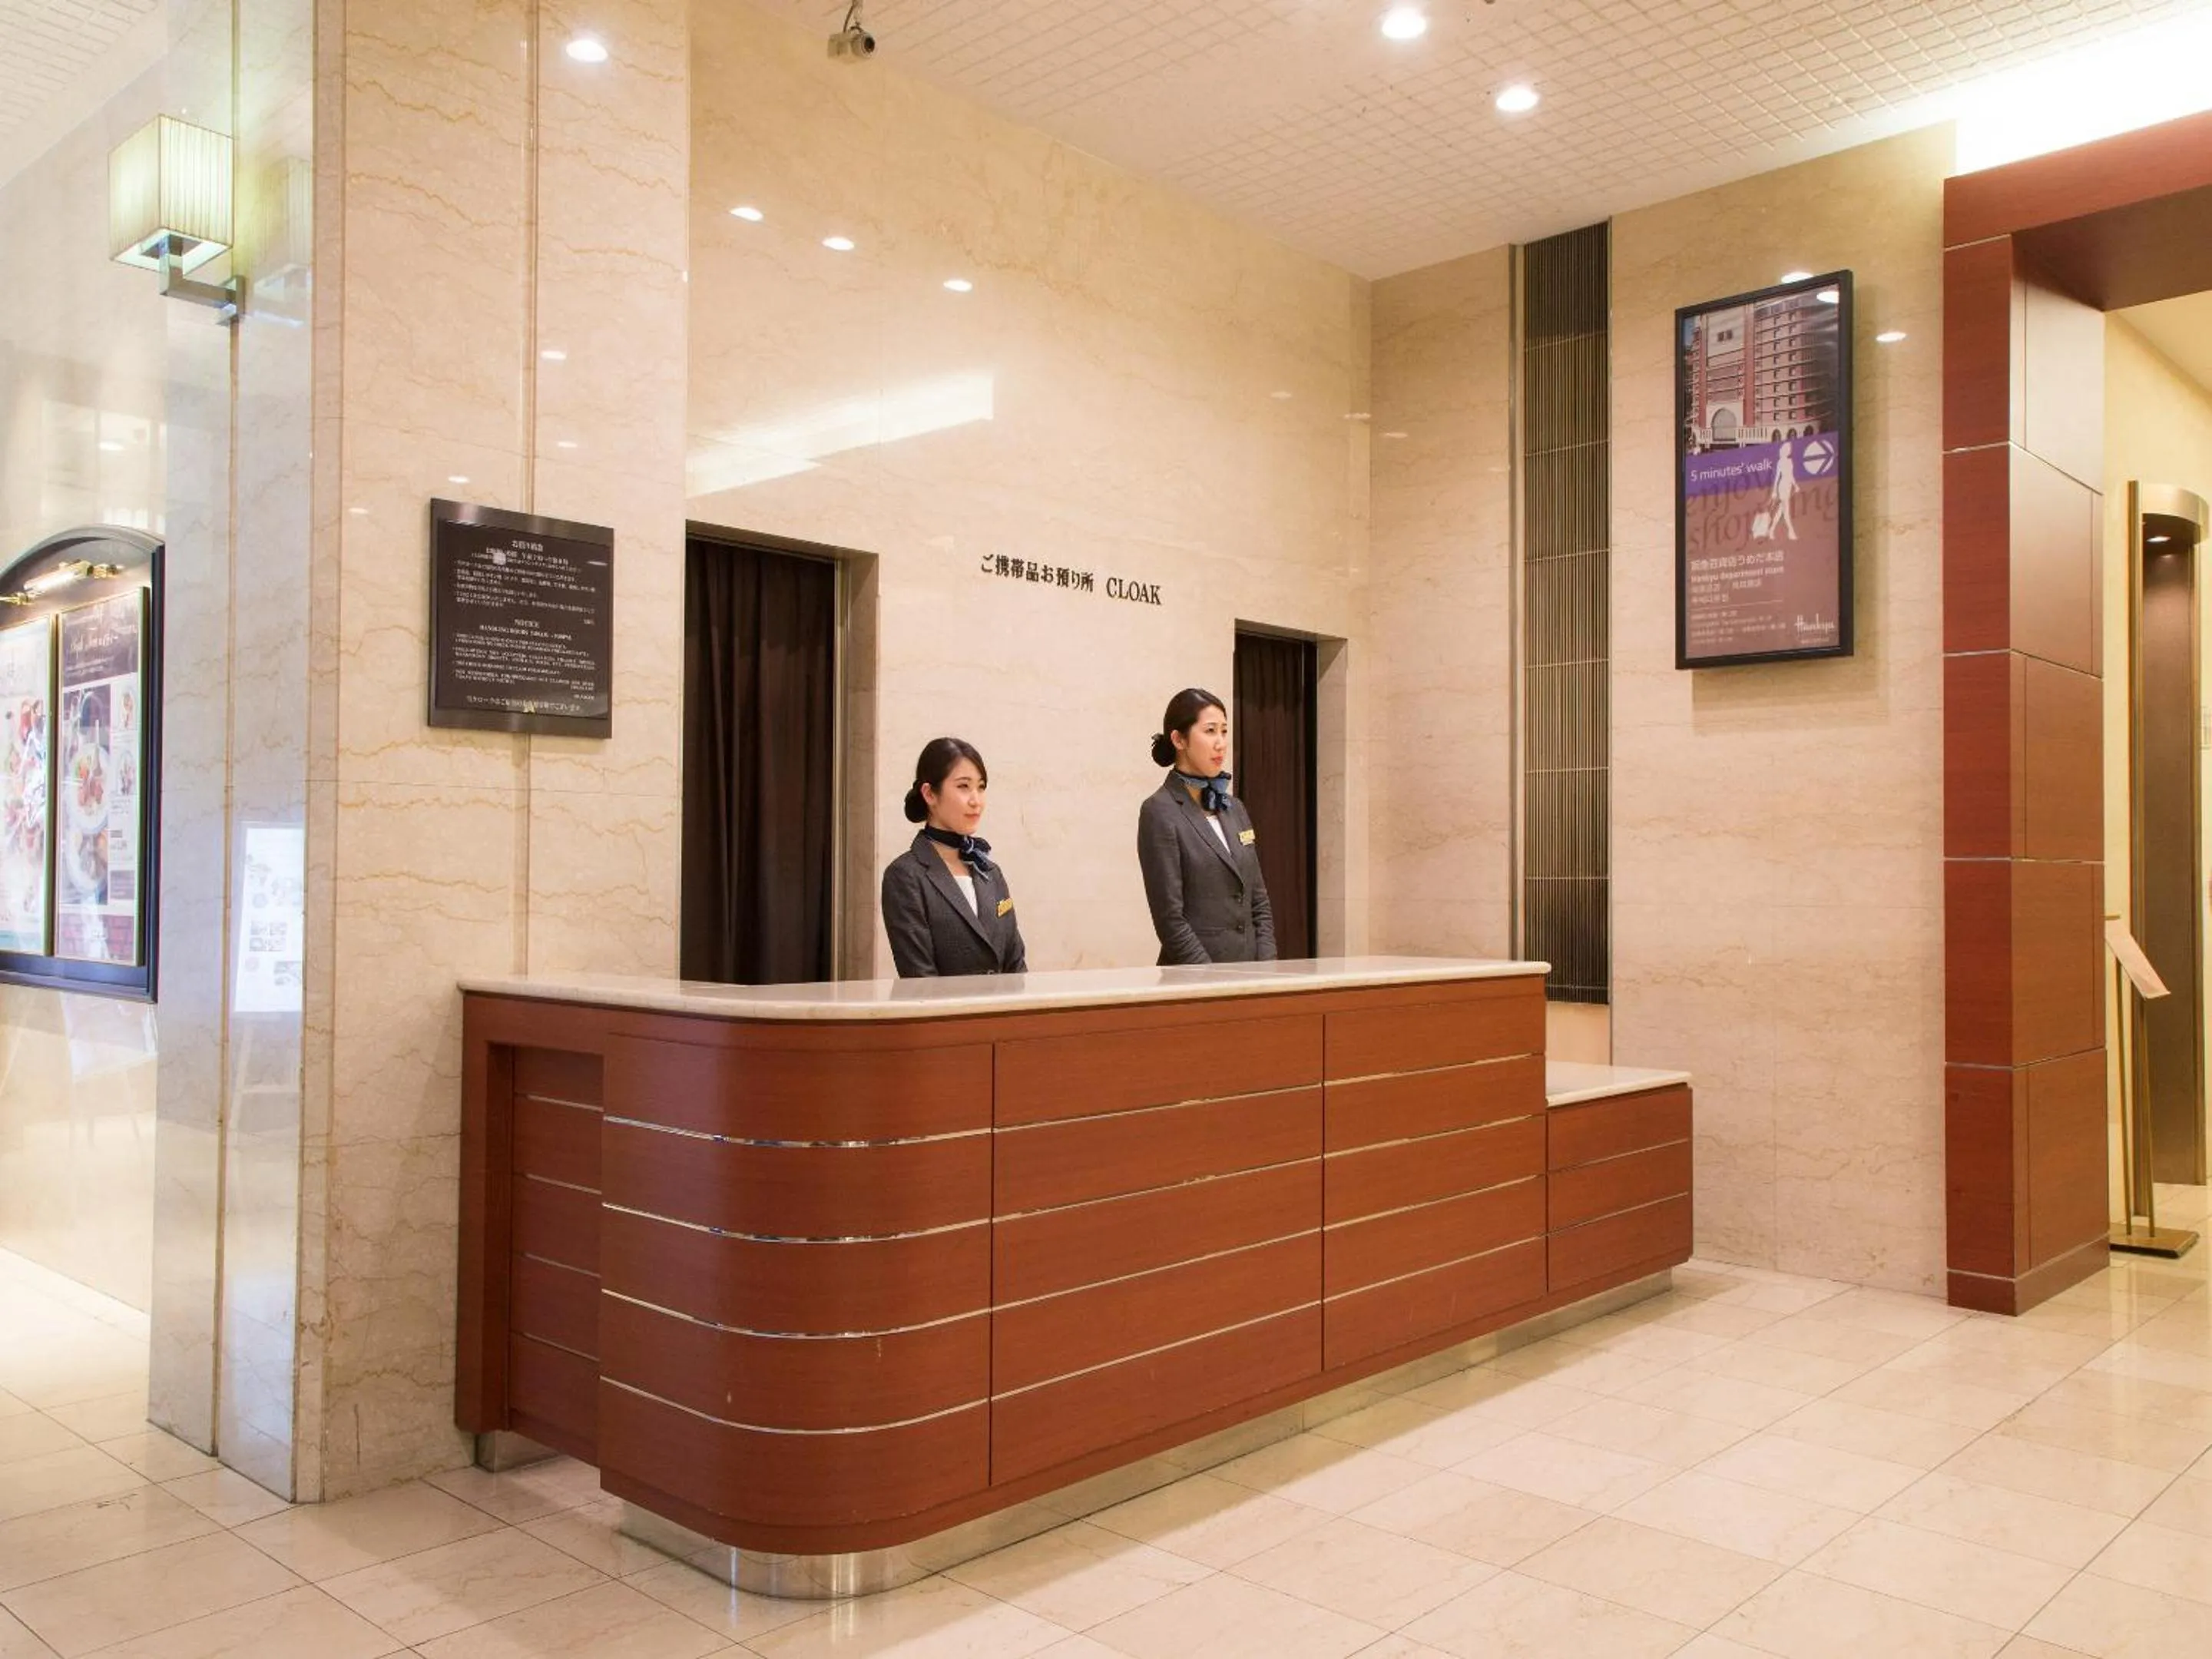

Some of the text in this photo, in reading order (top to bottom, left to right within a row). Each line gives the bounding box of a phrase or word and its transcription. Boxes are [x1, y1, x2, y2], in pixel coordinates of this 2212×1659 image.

[1690, 459, 1773, 482] 5 minutes' walk
[981, 554, 1162, 605] ご携帯品お預り所 CLOAK
